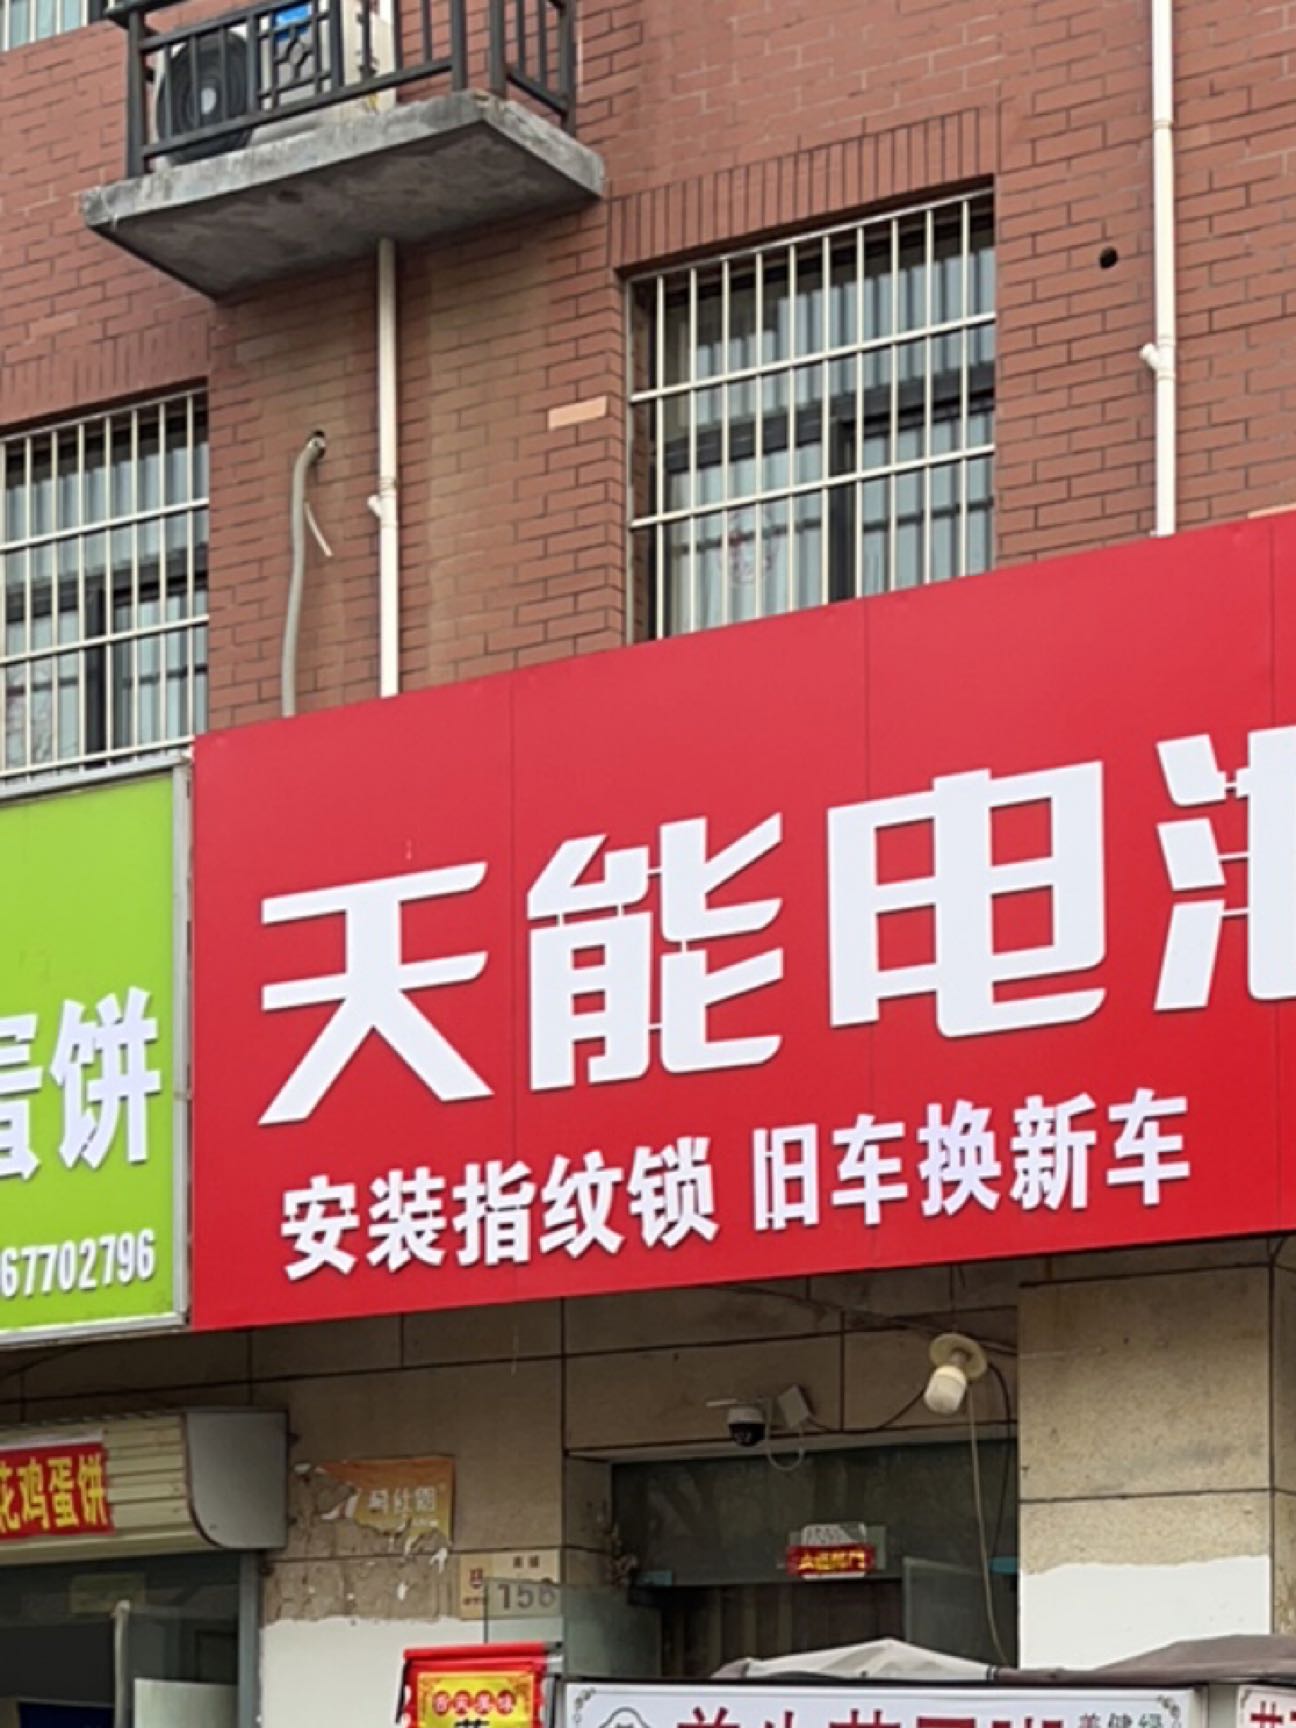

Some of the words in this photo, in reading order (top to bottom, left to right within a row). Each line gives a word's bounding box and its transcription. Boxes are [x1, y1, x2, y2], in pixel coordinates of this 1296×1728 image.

[280, 1137, 719, 1280] 安装指纹锁
[753, 1087, 1191, 1231] 旧车换新车
[0, 1227, 157, 1298] 67702796
